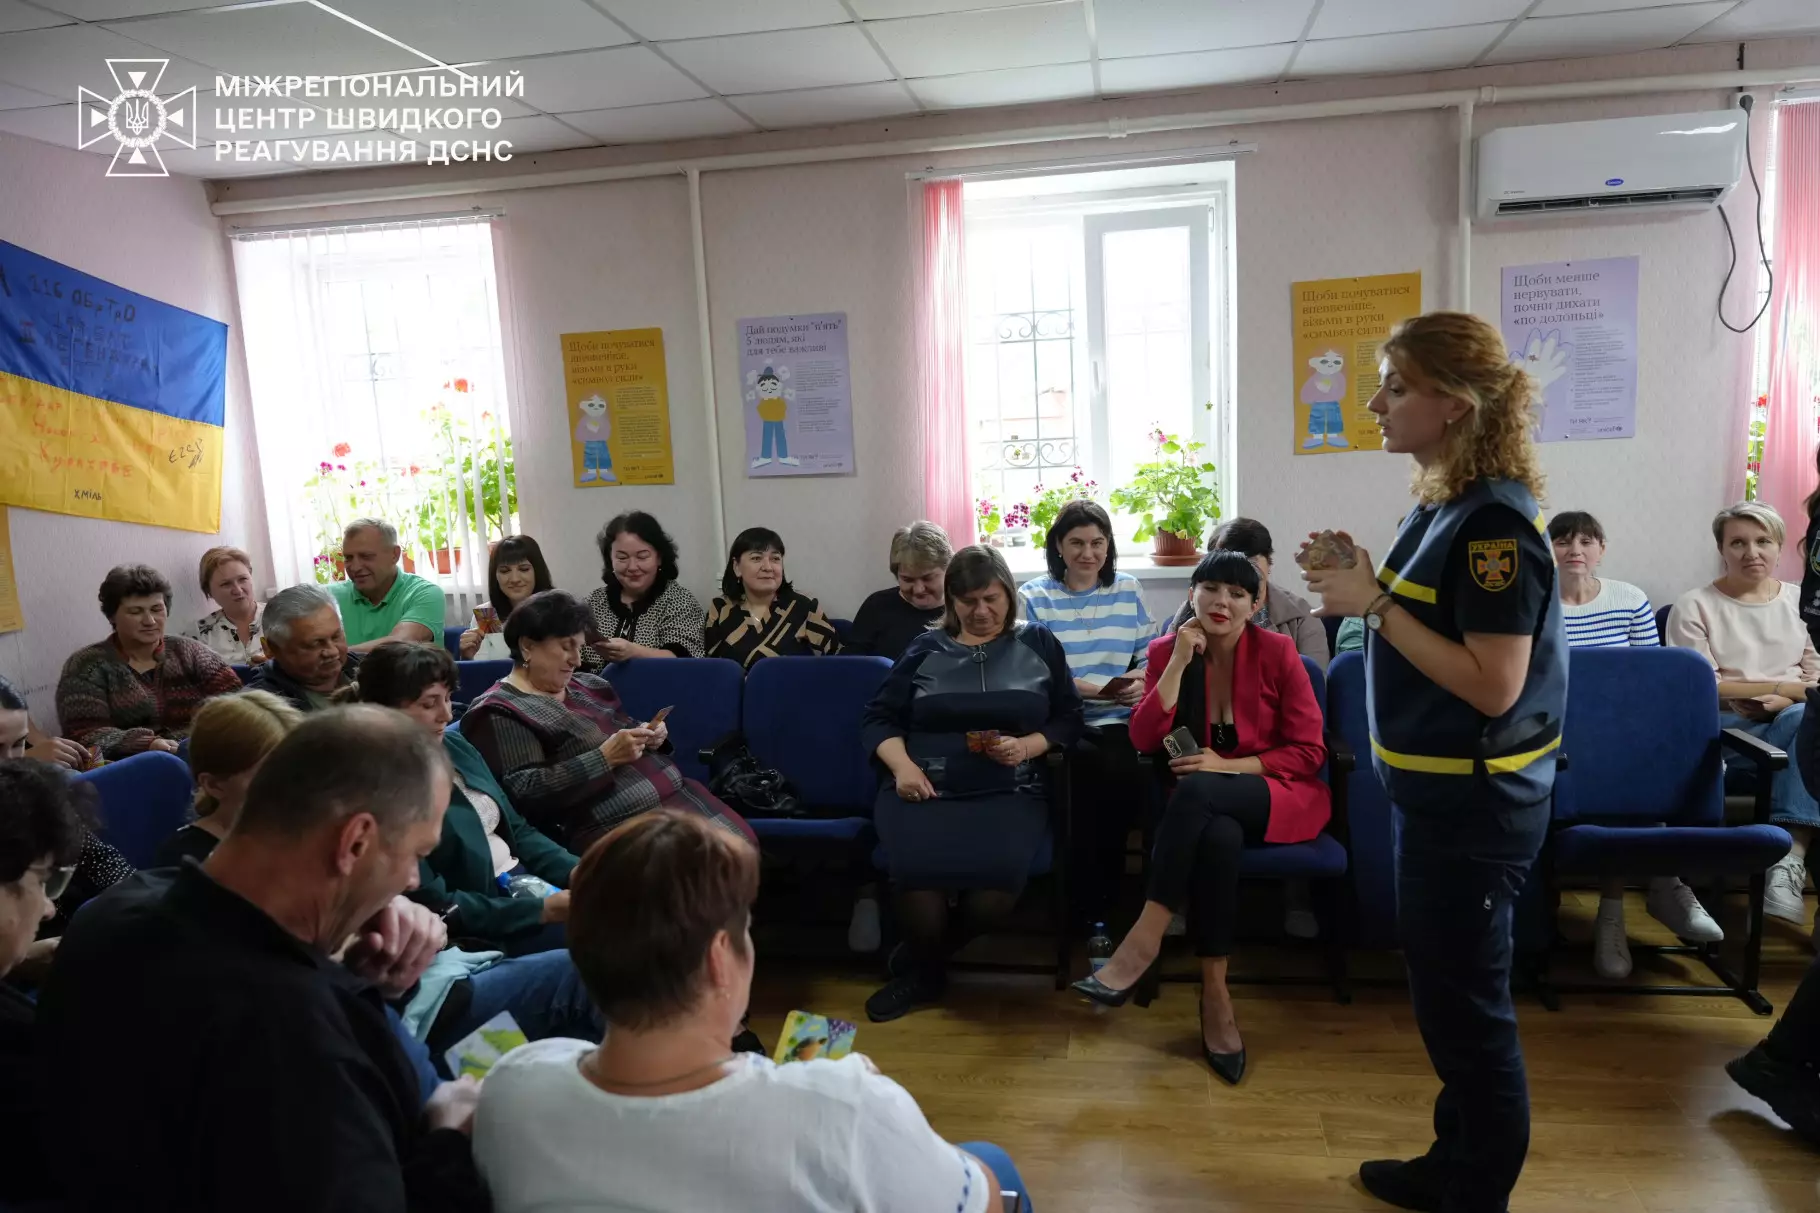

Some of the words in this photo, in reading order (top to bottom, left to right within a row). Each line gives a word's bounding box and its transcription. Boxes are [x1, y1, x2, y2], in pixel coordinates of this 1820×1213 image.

[1513, 273, 1552, 288] Щоби
[1555, 272, 1600, 283] менше
[1302, 290, 1338, 301] Щоби
[1341, 286, 1411, 300] почуватися
[1513, 287, 1582, 301] нервувати,
[1513, 302, 1552, 313] почни
[1555, 298, 1600, 311] дихати
[1302, 316, 1342, 327] візьми
[1345, 316, 1353, 324] в
[1356, 312, 1384, 325] руки
[1513, 316, 1536, 326] «по
[1539, 309, 1604, 325] долоньці»
[746, 325, 766, 336] Дай
[767, 324, 809, 335] подумки
[746, 336, 752, 346] 5
[791, 332, 806, 342] які
[747, 349, 764, 357] для
[766, 346, 787, 355] тебе
[1471, 541, 1514, 551] УКРАЇНА
